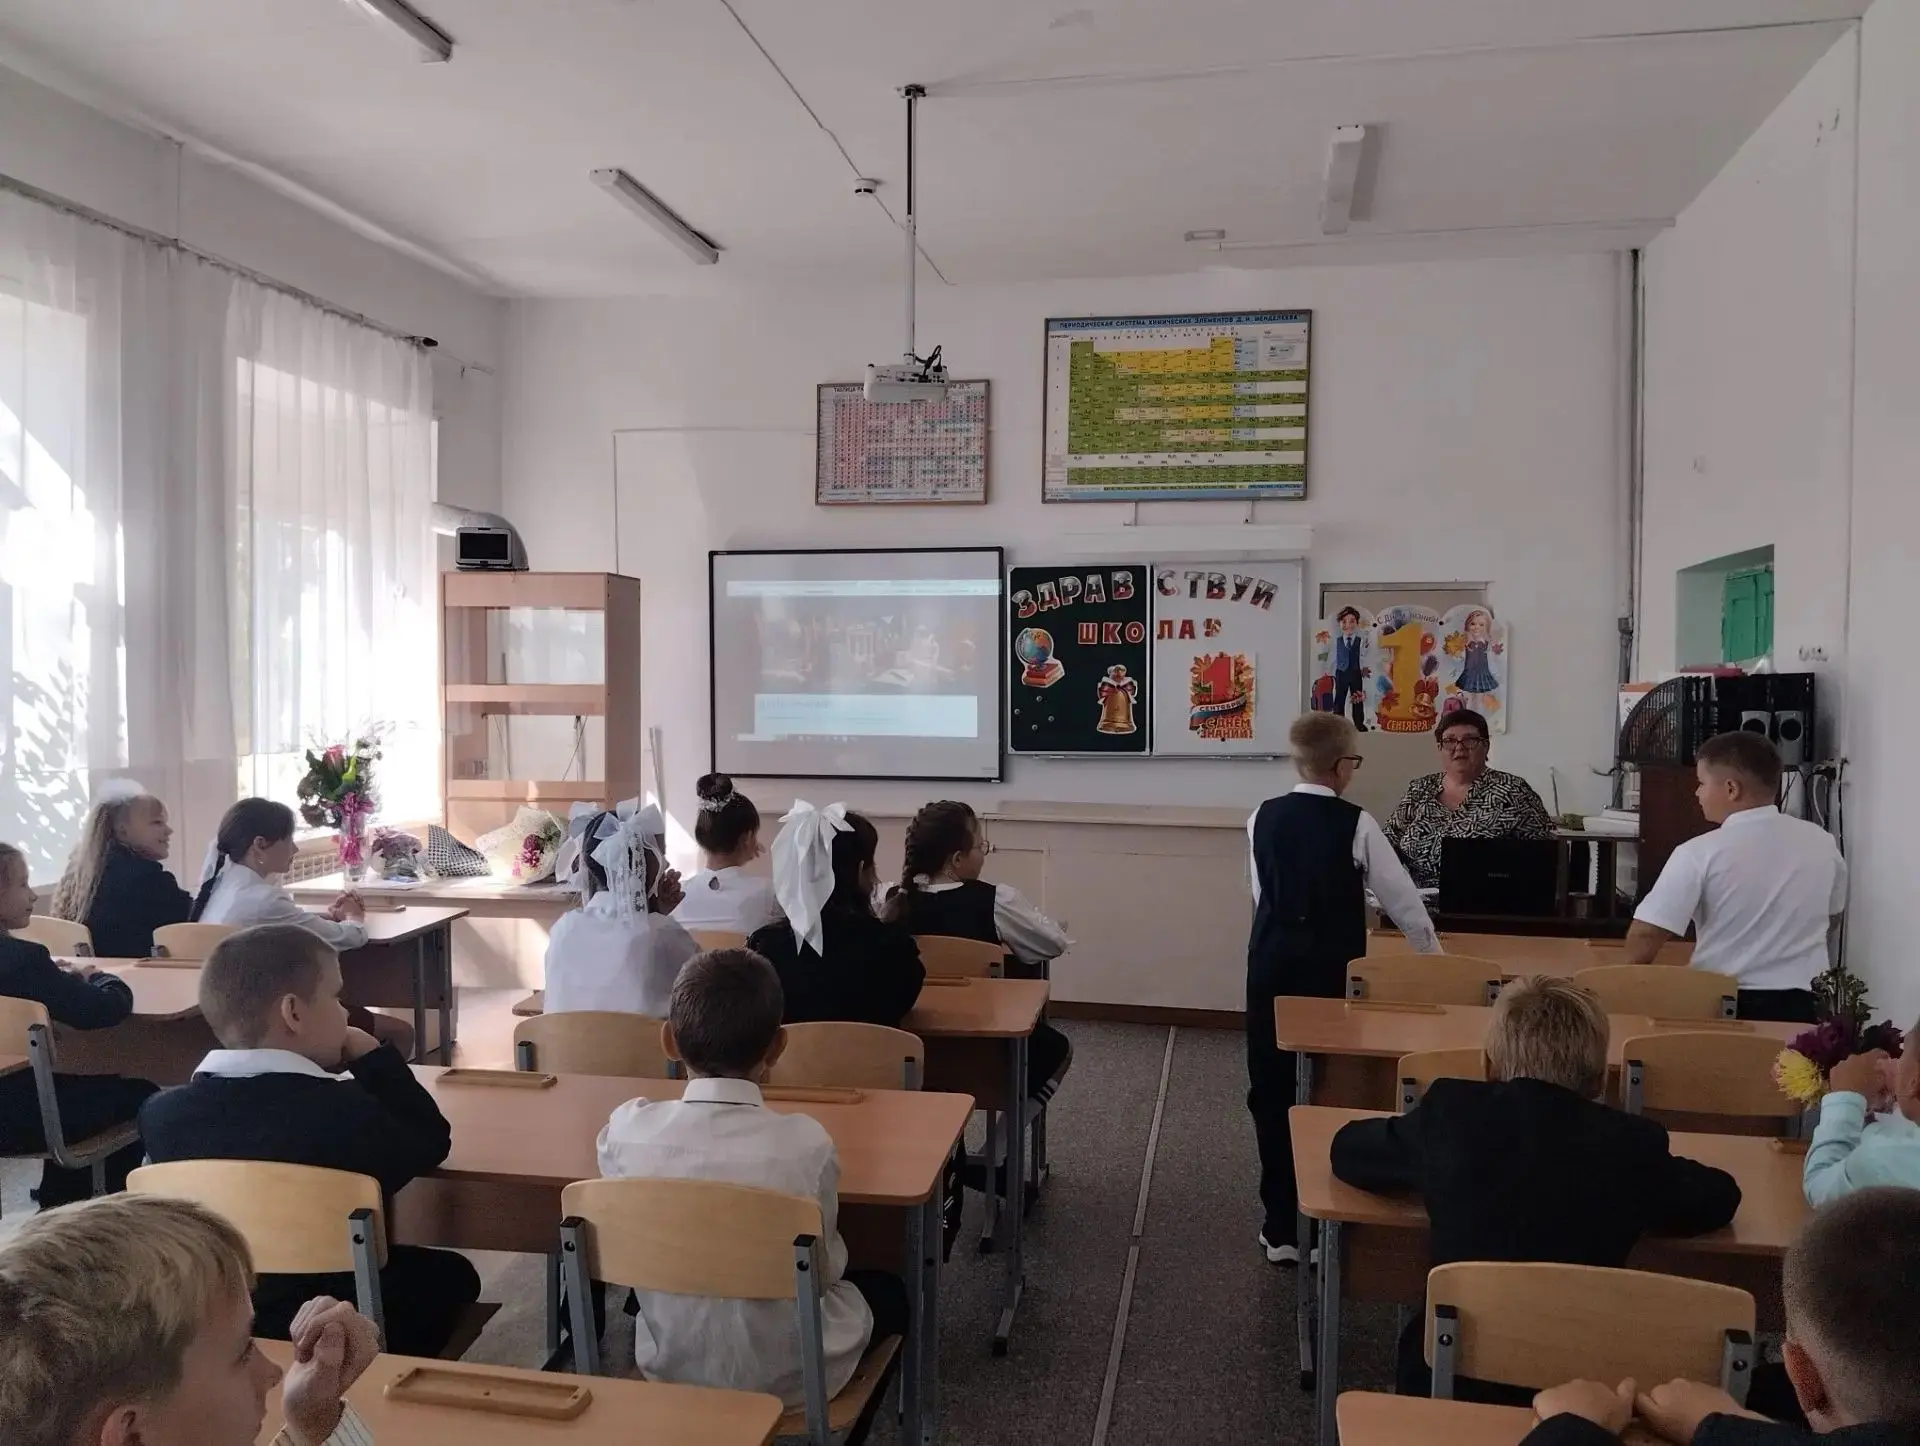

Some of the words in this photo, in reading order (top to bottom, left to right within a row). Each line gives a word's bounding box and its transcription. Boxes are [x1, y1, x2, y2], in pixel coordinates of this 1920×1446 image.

[1115, 319, 1146, 327] СИСТЕМА
[1148, 317, 1192, 325] ХИМИЧЕСКИХ
[1194, 316, 1234, 324] ЭЛЕМЕНТОВ
[1012, 570, 1135, 619] ЗДРАВ
[1078, 621, 1146, 645] ШКО
[1200, 700, 1242, 712] СЕНТЯБРЯ
[1386, 719, 1428, 731] СЕНТЯБРЯ
